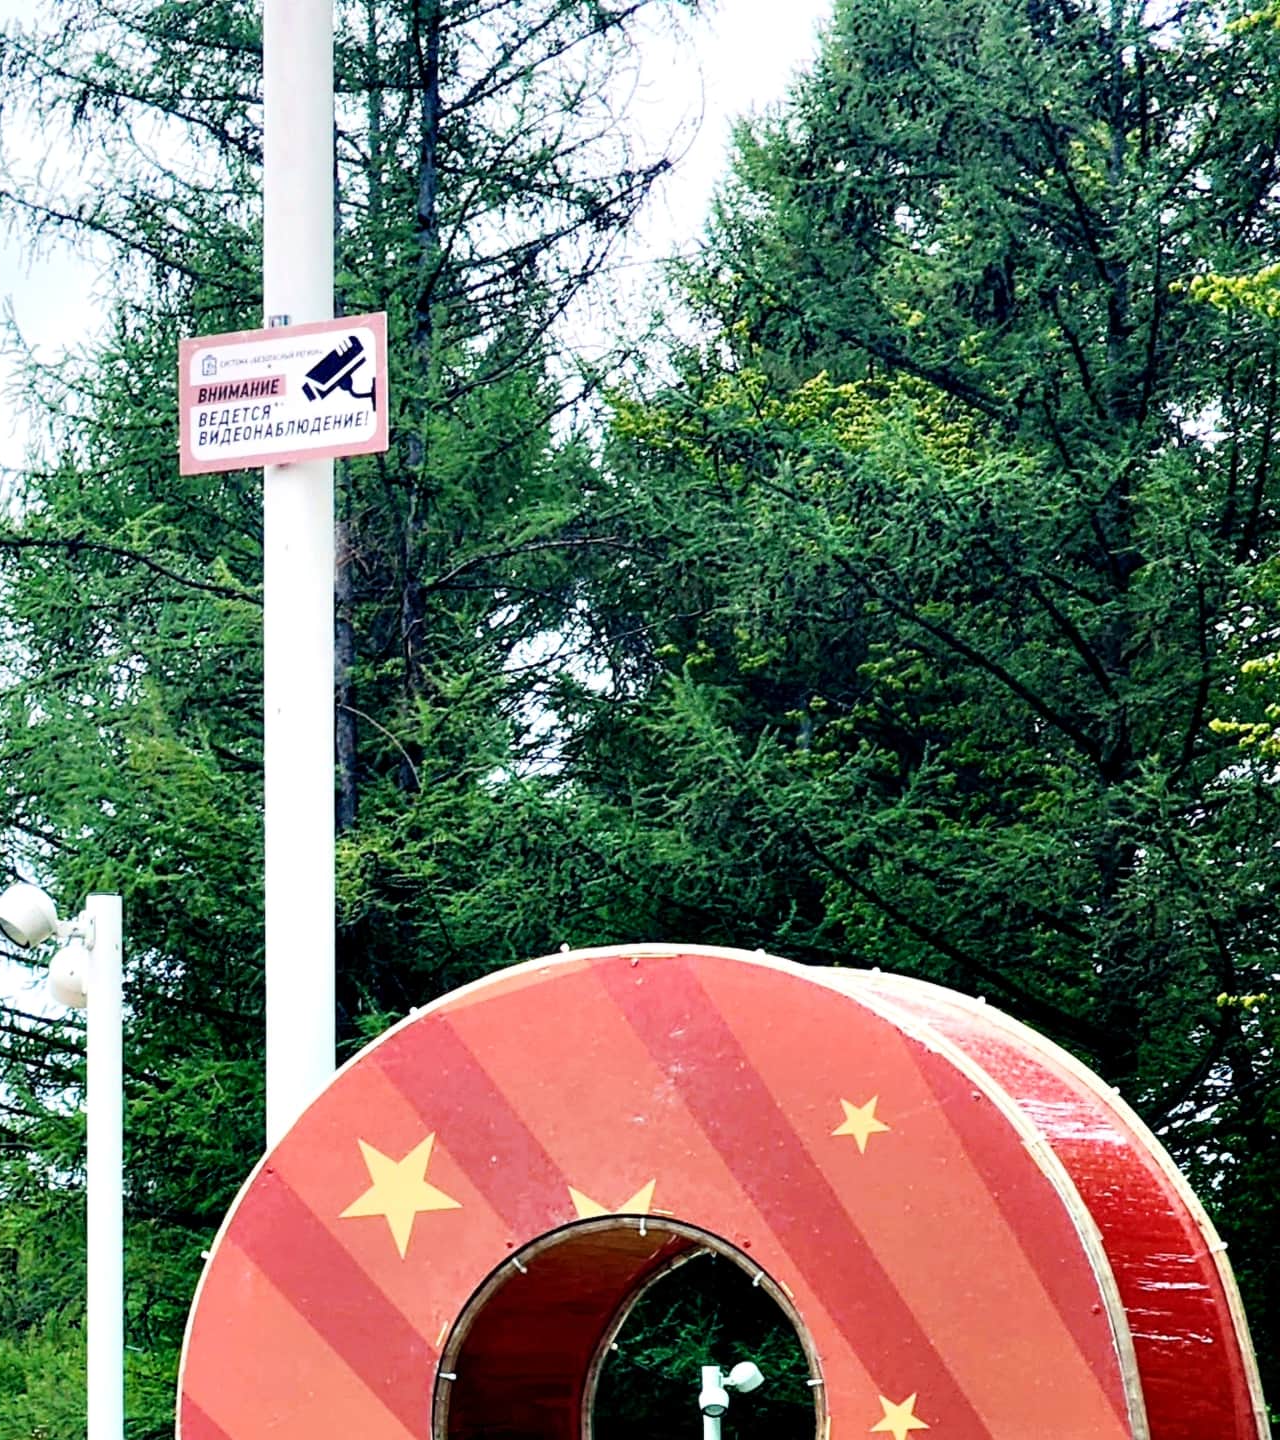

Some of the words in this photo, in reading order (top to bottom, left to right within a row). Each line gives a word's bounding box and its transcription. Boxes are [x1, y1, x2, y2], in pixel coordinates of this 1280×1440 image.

[197, 378, 280, 404] ВНИМАНИЕ
[198, 404, 272, 428] ВЕДЕТСЯ
[198, 411, 370, 447] ВИДЕОНАБЛЮДЕНИЕ!
